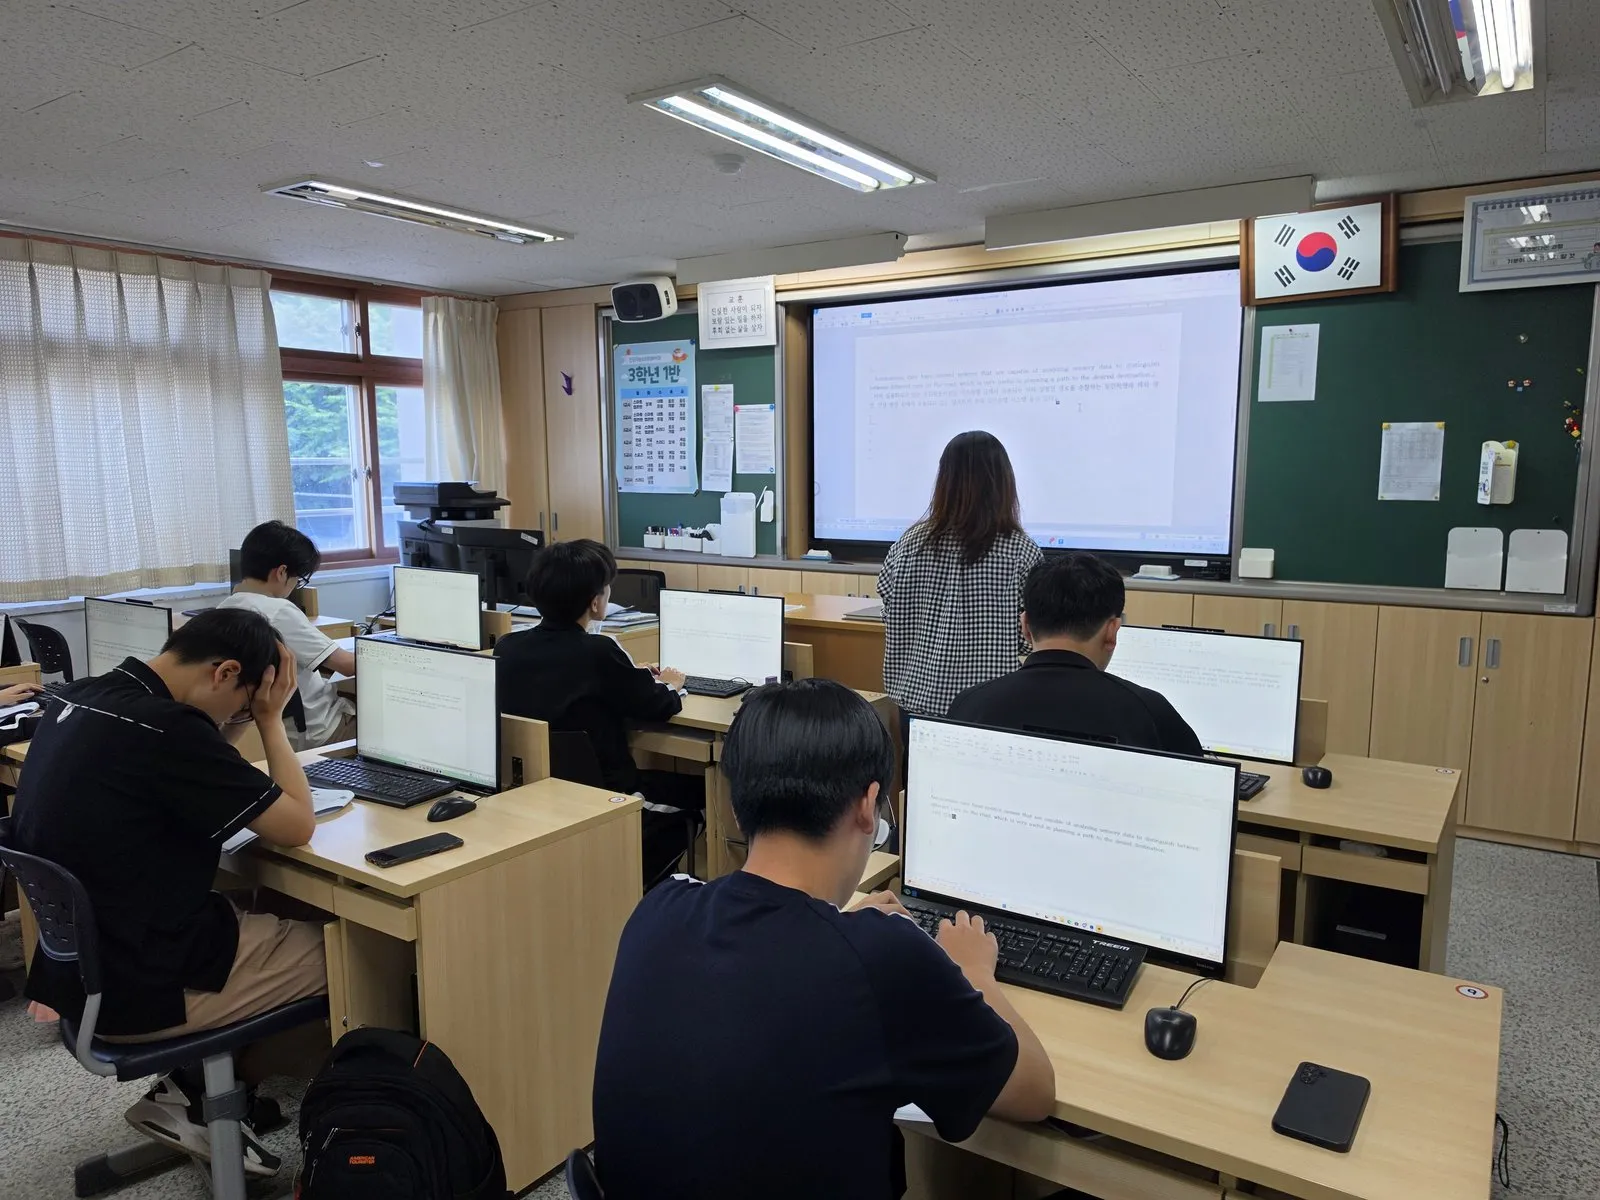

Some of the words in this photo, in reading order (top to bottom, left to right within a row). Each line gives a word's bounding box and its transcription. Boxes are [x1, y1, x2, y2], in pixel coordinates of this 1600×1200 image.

[712, 307, 728, 316] 진실한
[730, 305, 748, 313] 사람이
[712, 317, 722, 325] 보람
[724, 316, 735, 324] 있는
[751, 314, 762, 322] 하자
[725, 326, 736, 334] 없는
[628, 366, 659, 384] 3학년
[663, 365, 681, 383] 1반
[1093, 940, 1130, 950] TREEM
